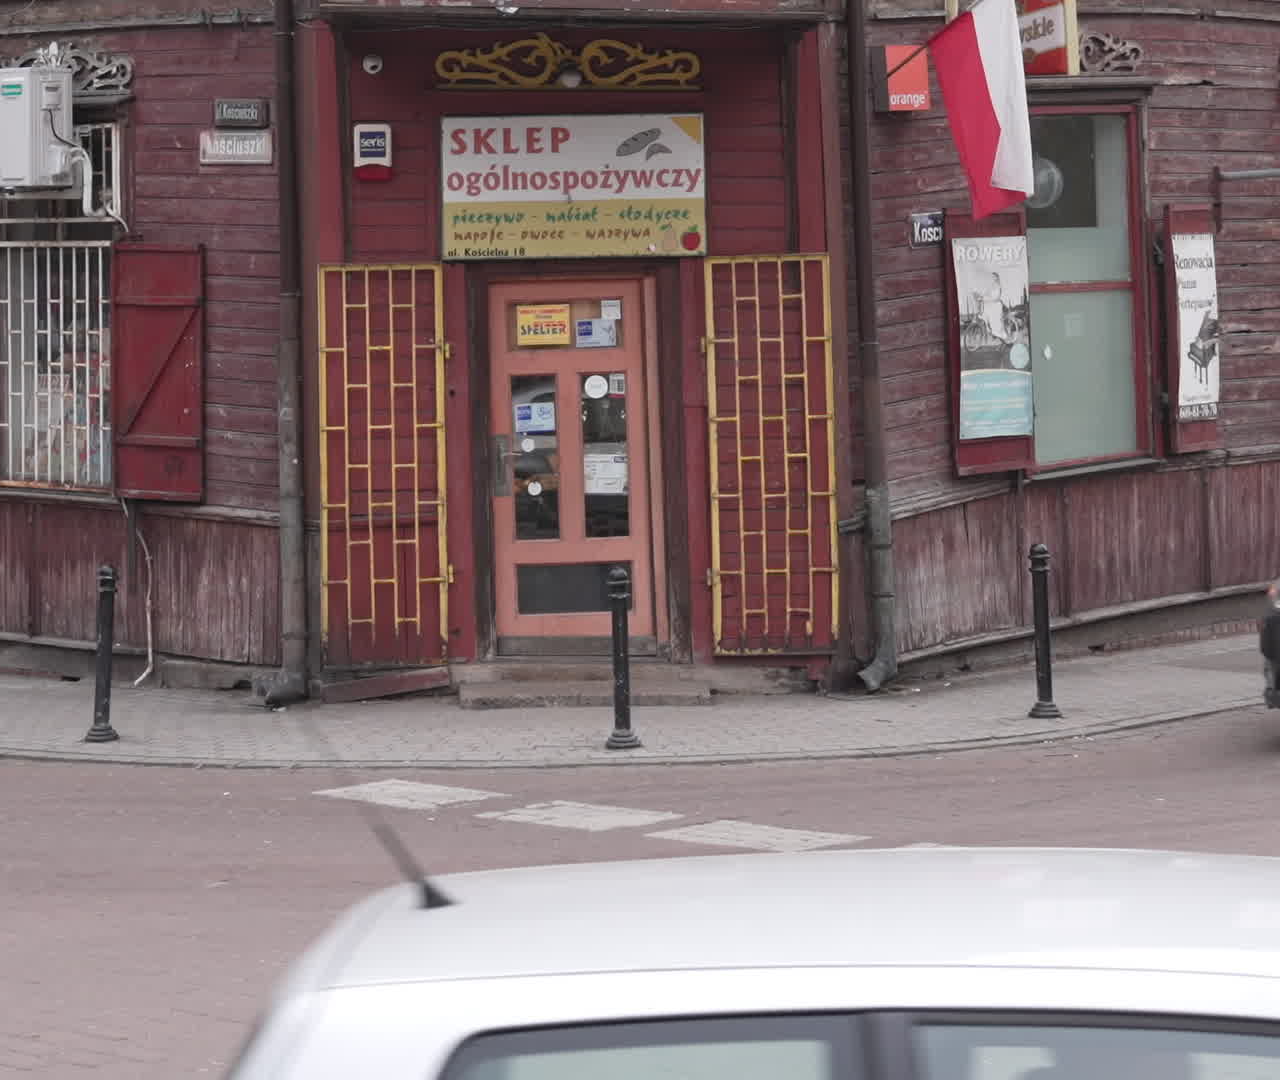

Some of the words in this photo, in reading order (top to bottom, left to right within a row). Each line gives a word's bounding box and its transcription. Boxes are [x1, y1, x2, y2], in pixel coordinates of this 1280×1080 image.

[889, 92, 926, 107] orange
[450, 127, 570, 155] SKLEP
[447, 163, 702, 197] ogólnospożywczy
[453, 208, 525, 226] pieczywo
[453, 230, 505, 244] napoje
[521, 230, 565, 241] owoce
[464, 247, 510, 257] Kościelna
[513, 248, 526, 256] 18
[956, 246, 1024, 264] ROWERY
